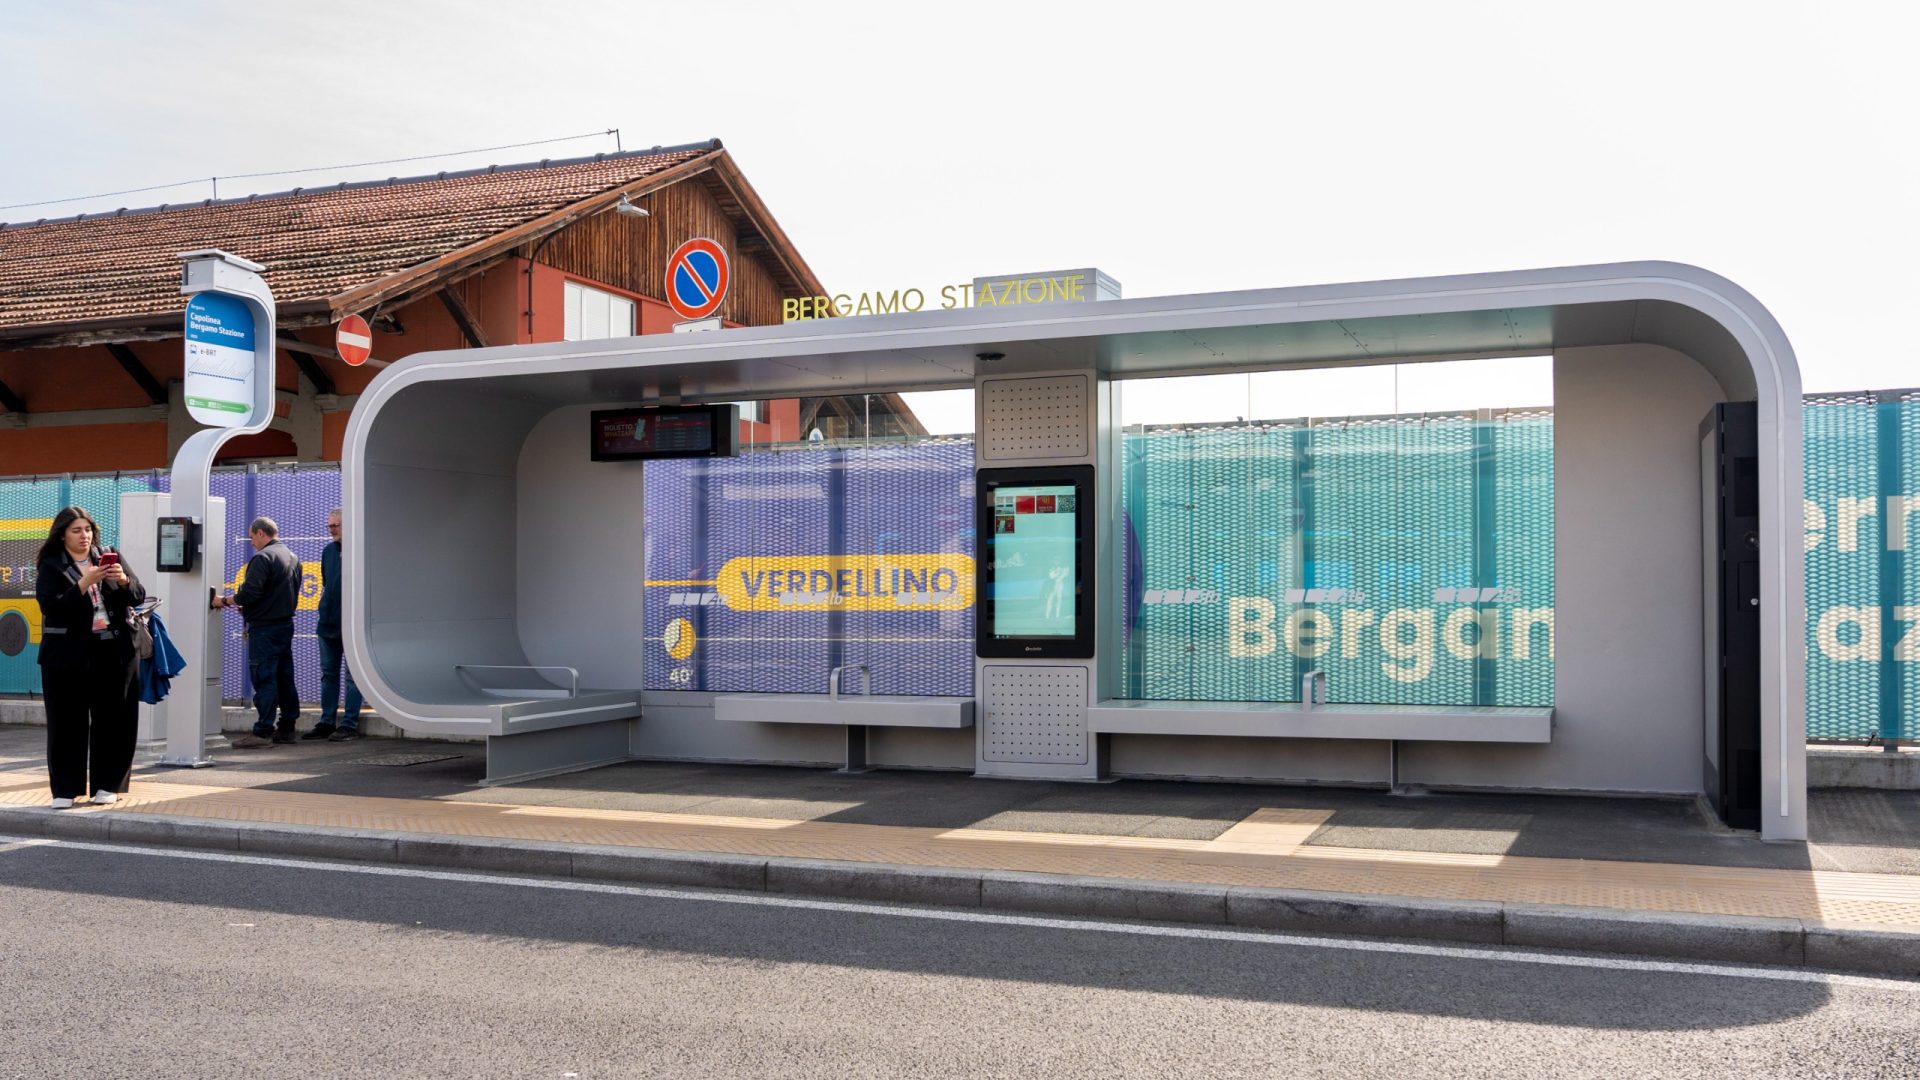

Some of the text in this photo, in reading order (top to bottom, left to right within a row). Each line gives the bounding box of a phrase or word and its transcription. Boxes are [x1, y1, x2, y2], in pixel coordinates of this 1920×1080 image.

[782, 273, 1085, 322] BERGAMO STAZIONE
[190, 312, 222, 325] Capolinea
[190, 320, 245, 339] Bergamo Stazione
[200, 349, 217, 357] e-BRT
[741, 567, 959, 598] VERDELLINO
